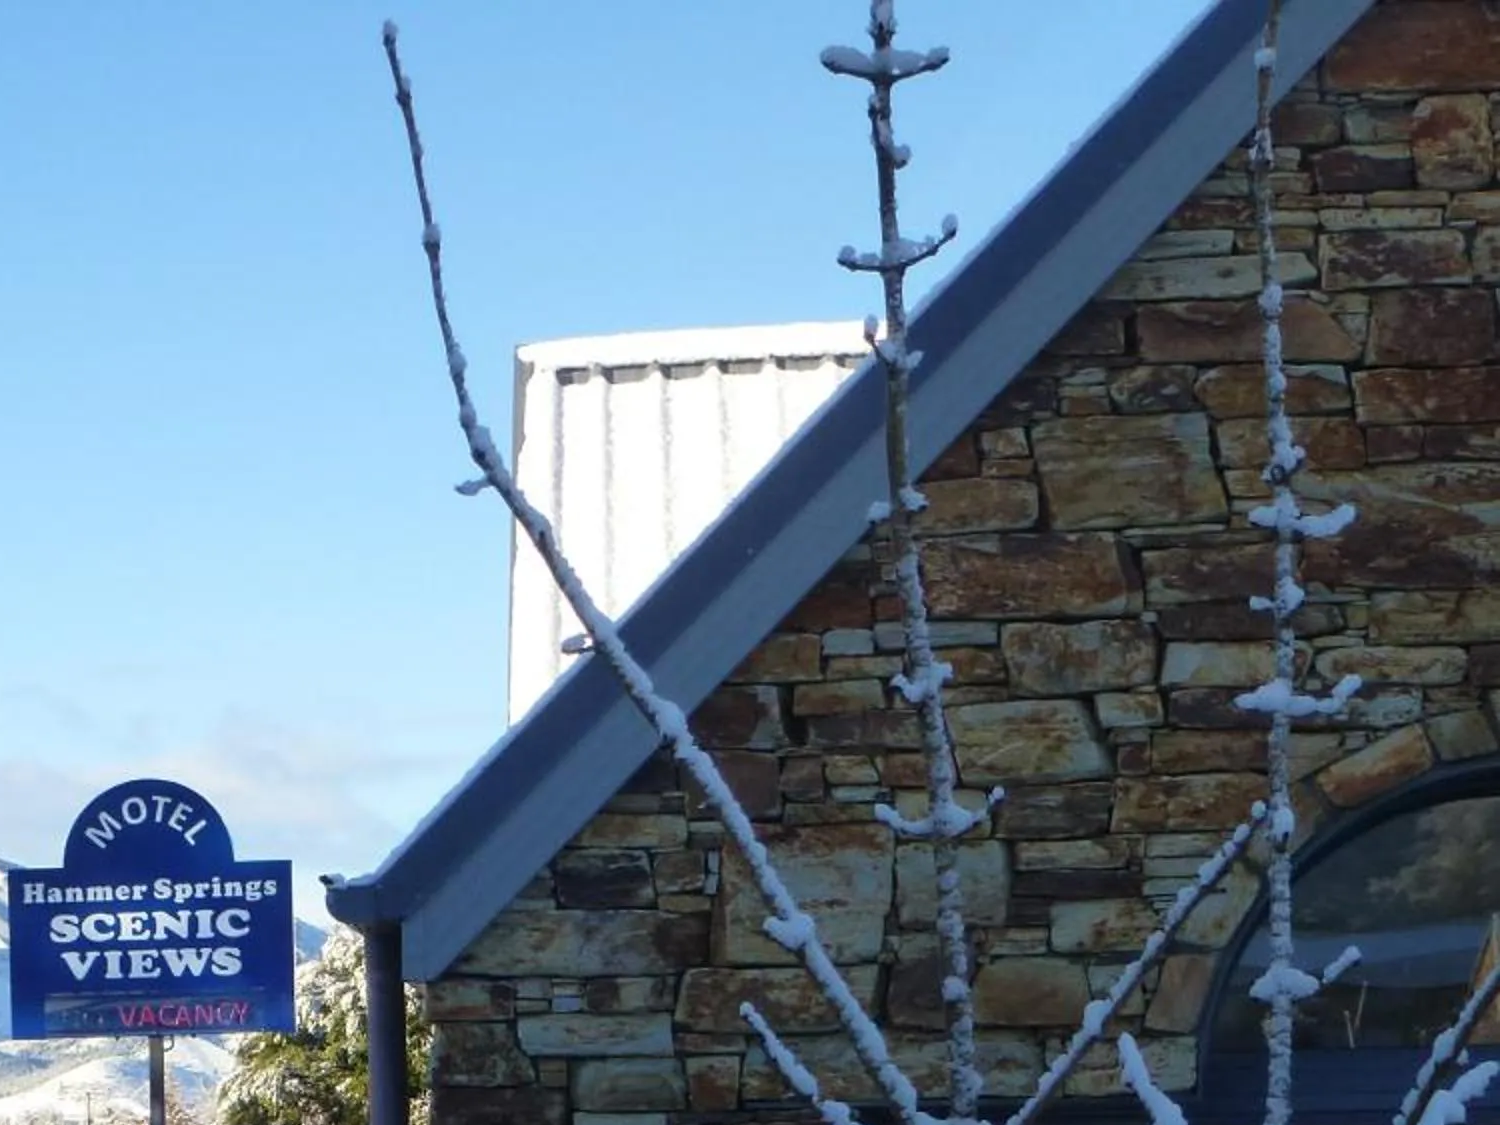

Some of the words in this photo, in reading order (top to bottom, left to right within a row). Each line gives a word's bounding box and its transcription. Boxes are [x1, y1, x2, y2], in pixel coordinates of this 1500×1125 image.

[85, 795, 206, 849] MOTEL
[23, 882, 148, 904] Hanmer
[155, 877, 277, 903] Springs
[50, 908, 250, 943] SCENIC
[61, 947, 242, 980] VIEWS
[117, 1001, 249, 1027] VACANCY
